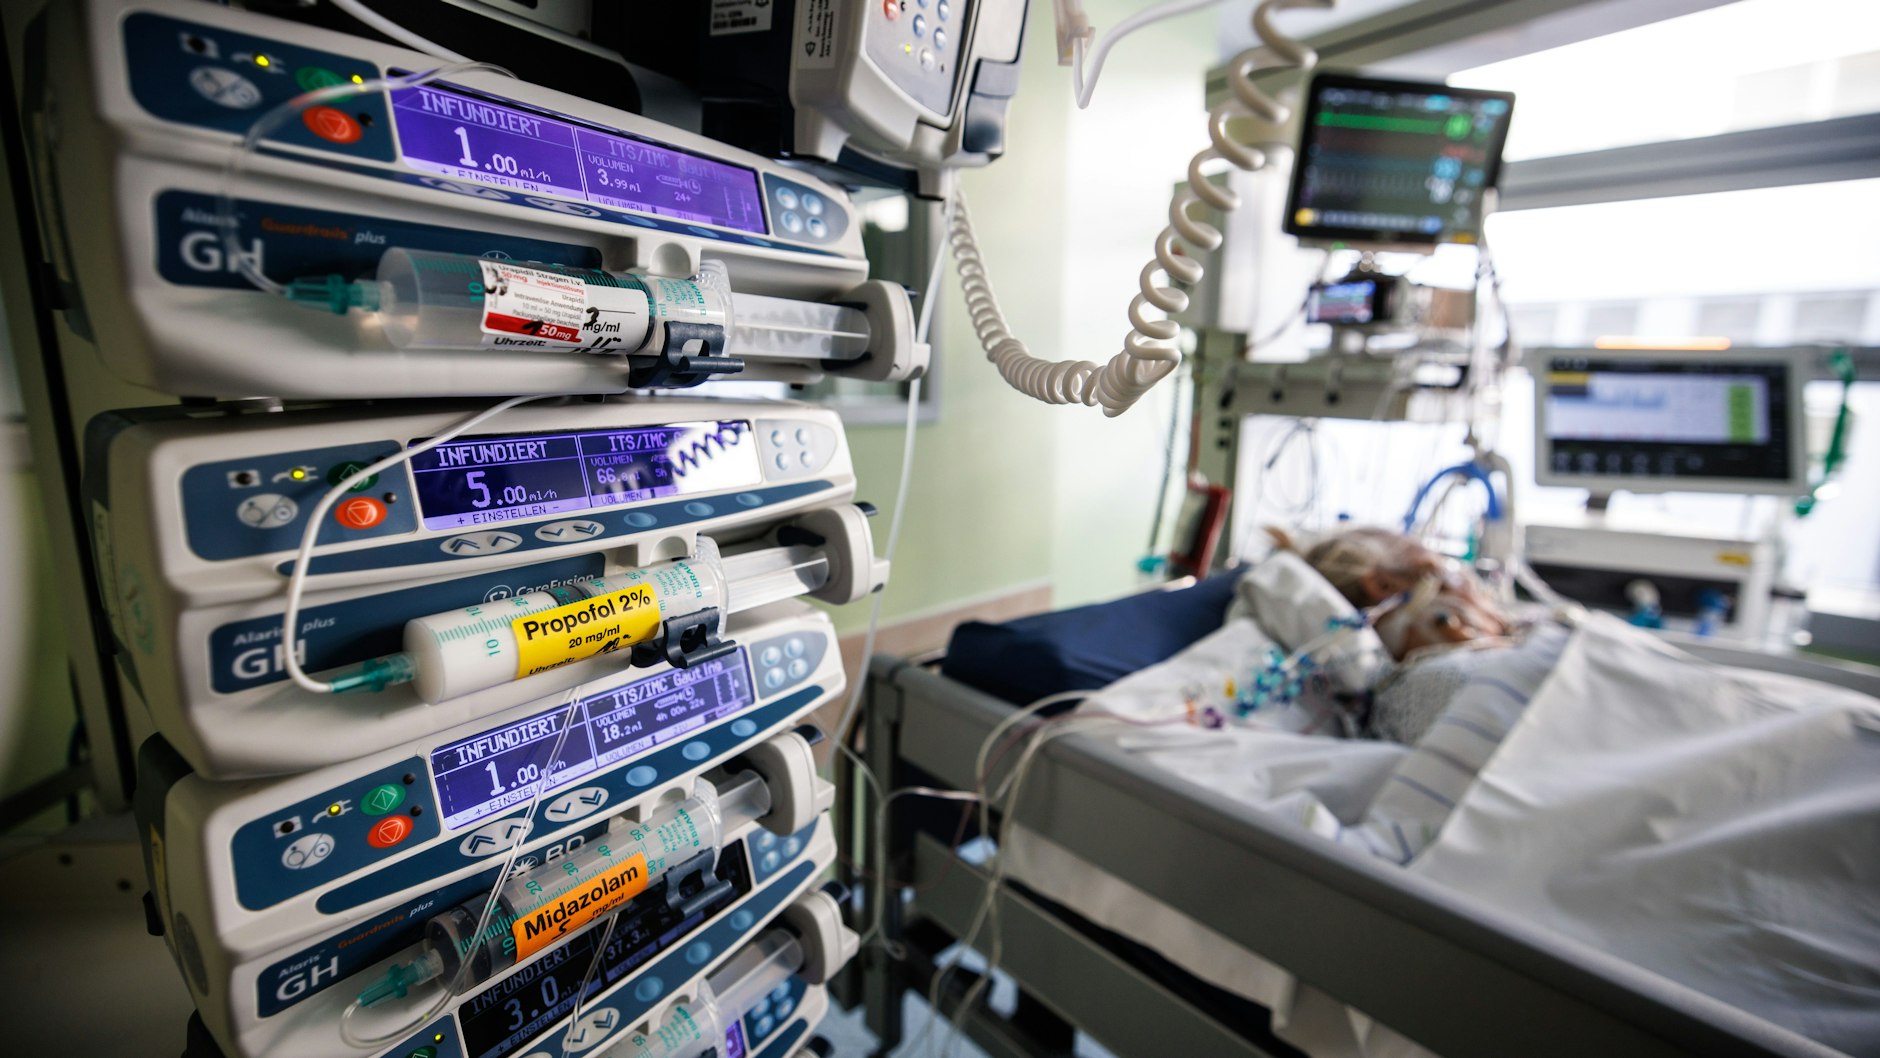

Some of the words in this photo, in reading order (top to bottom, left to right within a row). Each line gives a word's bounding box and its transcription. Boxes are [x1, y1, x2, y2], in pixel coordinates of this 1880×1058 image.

[418, 90, 541, 138] INFUNDIERT
[608, 139, 671, 168] ITS/IMC
[588, 155, 634, 173] VOLUMEN
[354, 230, 387, 246] plus
[513, 274, 528, 284] mg
[536, 271, 570, 285] Stragen
[551, 300, 584, 313] Anwendung
[540, 325, 557, 337] 50
[556, 331, 572, 341] mg
[583, 321, 620, 333] mg/ml
[494, 337, 546, 347] Uhrzeit:
[608, 433, 668, 452] ITS/IMC
[437, 441, 547, 467] INFUNDIERT
[591, 454, 632, 466] VOLUMEN
[601, 492, 642, 504] VOLUMEN
[473, 505, 546, 524] EINSTELLEN
[516, 574, 594, 597] CareFusion
[523, 599, 617, 641] Propofol
[619, 589, 651, 614] 2%
[302, 616, 337, 634] plus
[568, 636, 583, 649] 20
[585, 624, 620, 646] mg/ml
[486, 638, 501, 657] 10
[232, 639, 307, 679] GH
[529, 656, 576, 675] Uhrzeit:
[612, 679, 668, 709] ITS/IMC
[596, 707, 636, 728] VOLUMEN
[656, 712, 668, 722] 4h
[456, 713, 558, 766] INFUNDIERT
[605, 740, 645, 762] VOLUMEN
[630, 829, 644, 841] 50
[545, 835, 586, 865] BD
[597, 845, 612, 857] 40
[562, 862, 579, 876] 30
[647, 860, 656, 875] 50
[525, 880, 543, 895] 20
[409, 900, 434, 918] plus
[524, 867, 639, 940] Midazolam
[592, 893, 625, 916] mg/ml
[338, 914, 405, 949] Guardrails
[502, 937, 515, 955] 10
[278, 953, 321, 981] Alaris
[276, 955, 339, 1001] GH
[471, 942, 572, 1014] INFUNDIERT
